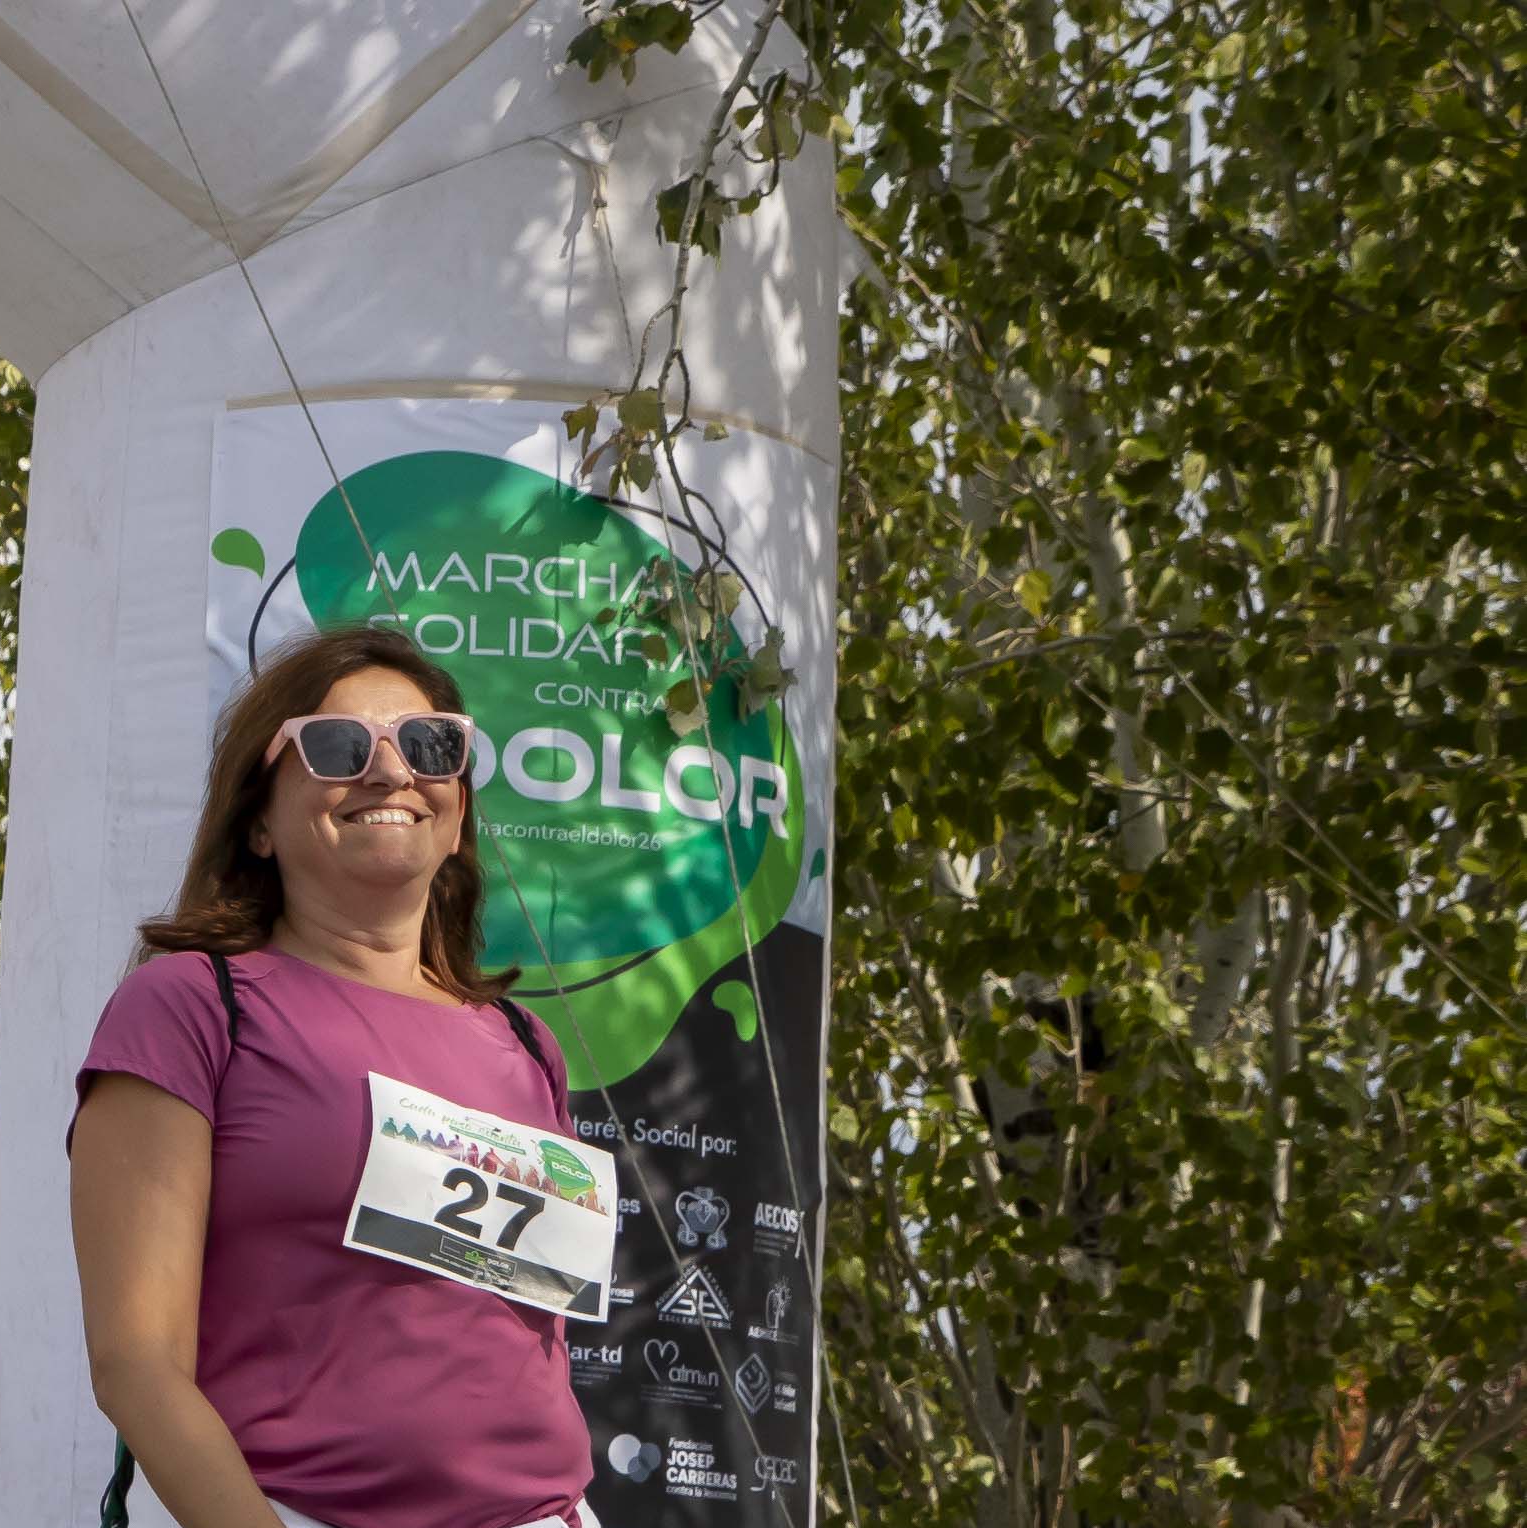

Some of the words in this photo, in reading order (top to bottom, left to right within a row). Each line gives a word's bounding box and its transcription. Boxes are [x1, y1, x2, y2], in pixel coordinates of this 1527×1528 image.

[367, 613, 710, 679] OLIDARA
[632, 1118, 697, 1150] Social
[701, 1134, 737, 1158] por:
[434, 1168, 546, 1252] 27
[666, 1450, 716, 1469] JOSEP
[666, 1466, 738, 1490] CARRERAS
